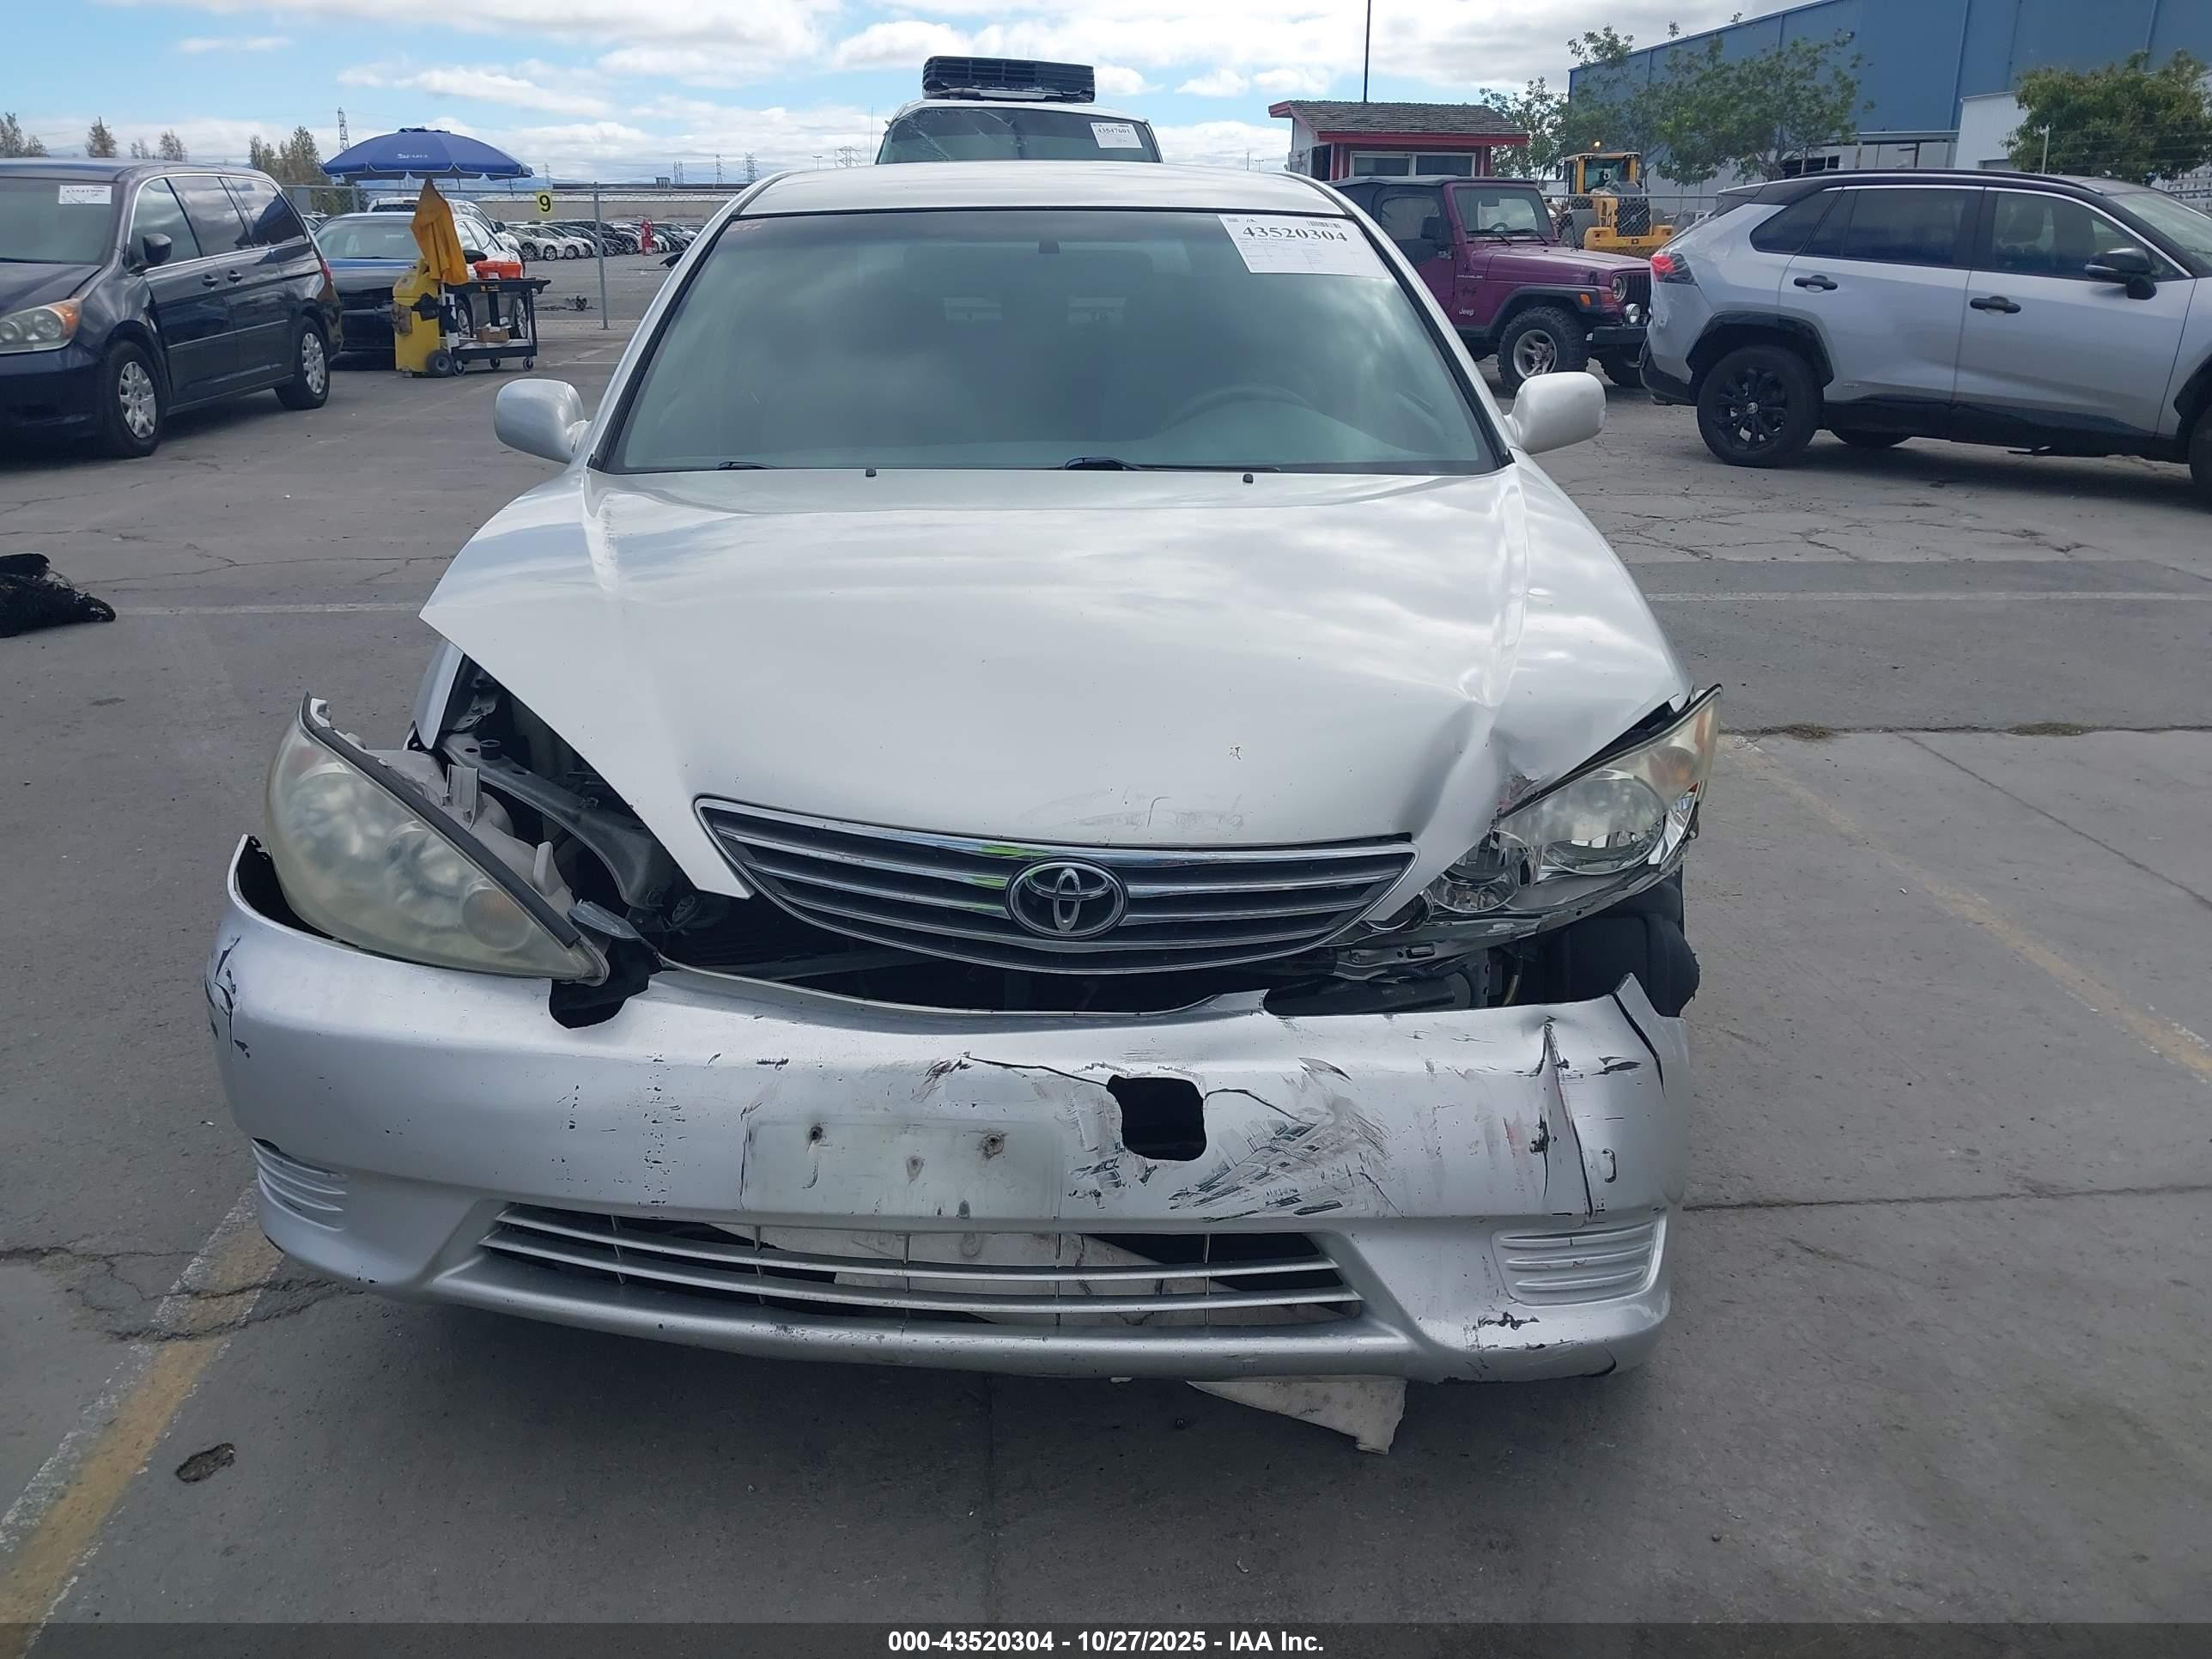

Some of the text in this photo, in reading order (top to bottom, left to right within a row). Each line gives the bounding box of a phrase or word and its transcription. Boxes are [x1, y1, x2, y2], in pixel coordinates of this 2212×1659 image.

[539, 194, 551, 212] 9
[1243, 227, 1348, 242] 43520304
[1459, 307, 1474, 316] Jeep
